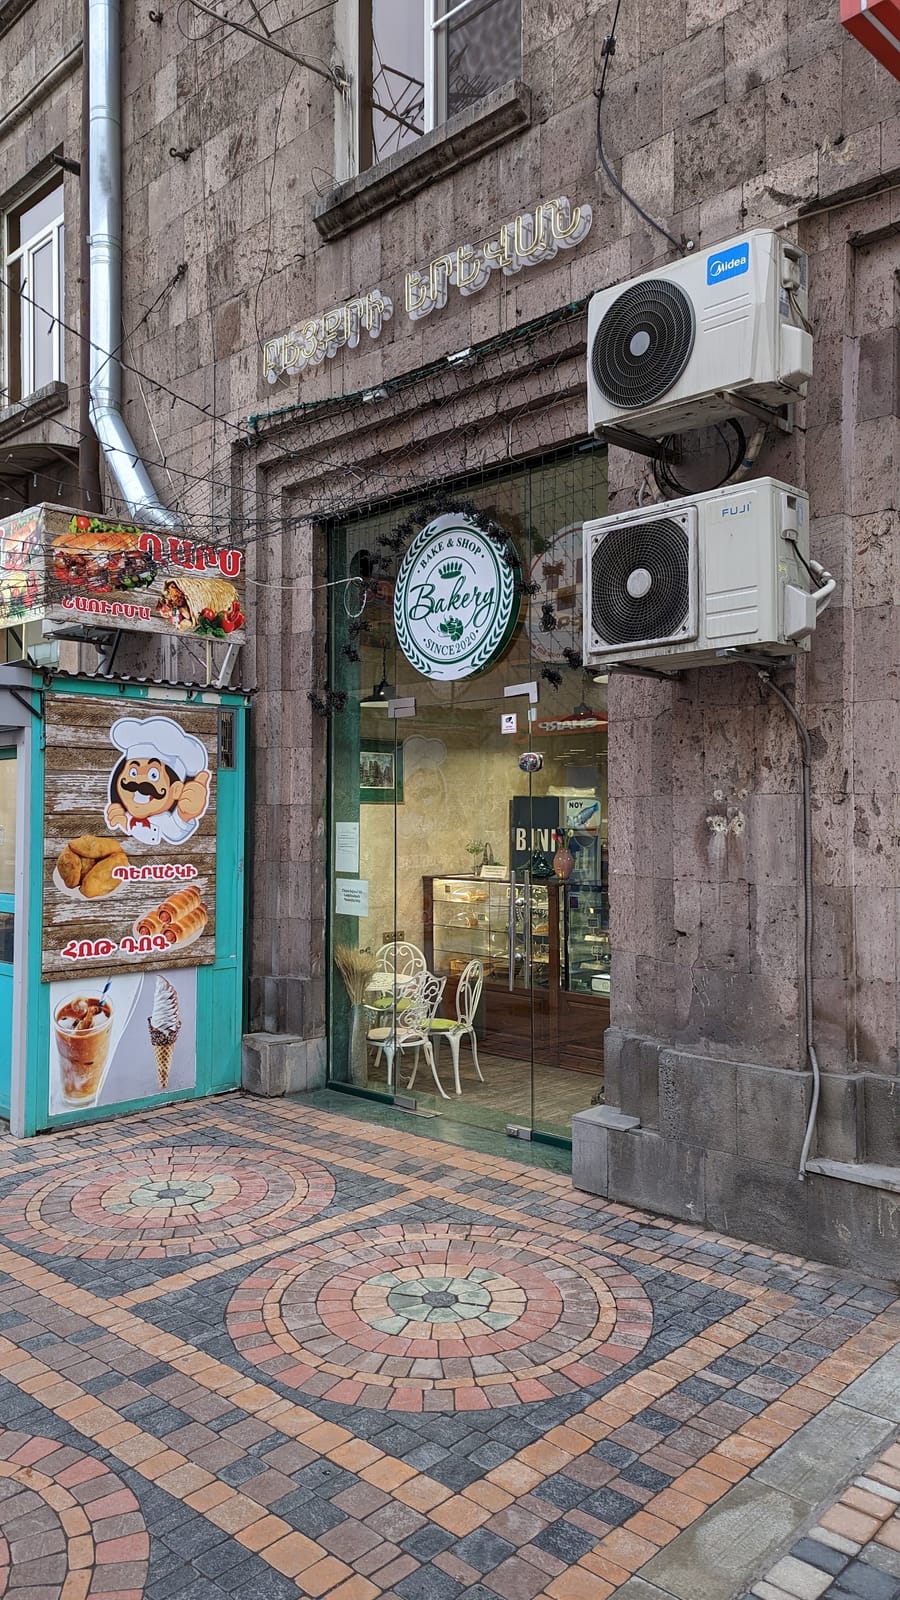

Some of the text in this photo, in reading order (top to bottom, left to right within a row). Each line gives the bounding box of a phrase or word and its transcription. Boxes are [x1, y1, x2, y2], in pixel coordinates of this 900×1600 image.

[405, 196, 592, 320] ԵՐԵՎԱՆ
[710, 256, 747, 277] Midea
[722, 504, 750, 517] FUJI
[138, 532, 242, 577] ՂԱՐՍ
[420, 537, 482, 569] BAKE & SHOP
[62, 595, 151, 620] ՇԱՈՒՐՄԱ
[409, 575, 496, 628] Bakery
[425, 631, 477, 656] SINCE 2020
[114, 865, 197, 880] ՊԵՐԱՇԿԻ
[62, 936, 170, 959] ՀՈԹ ԴՈԳ
